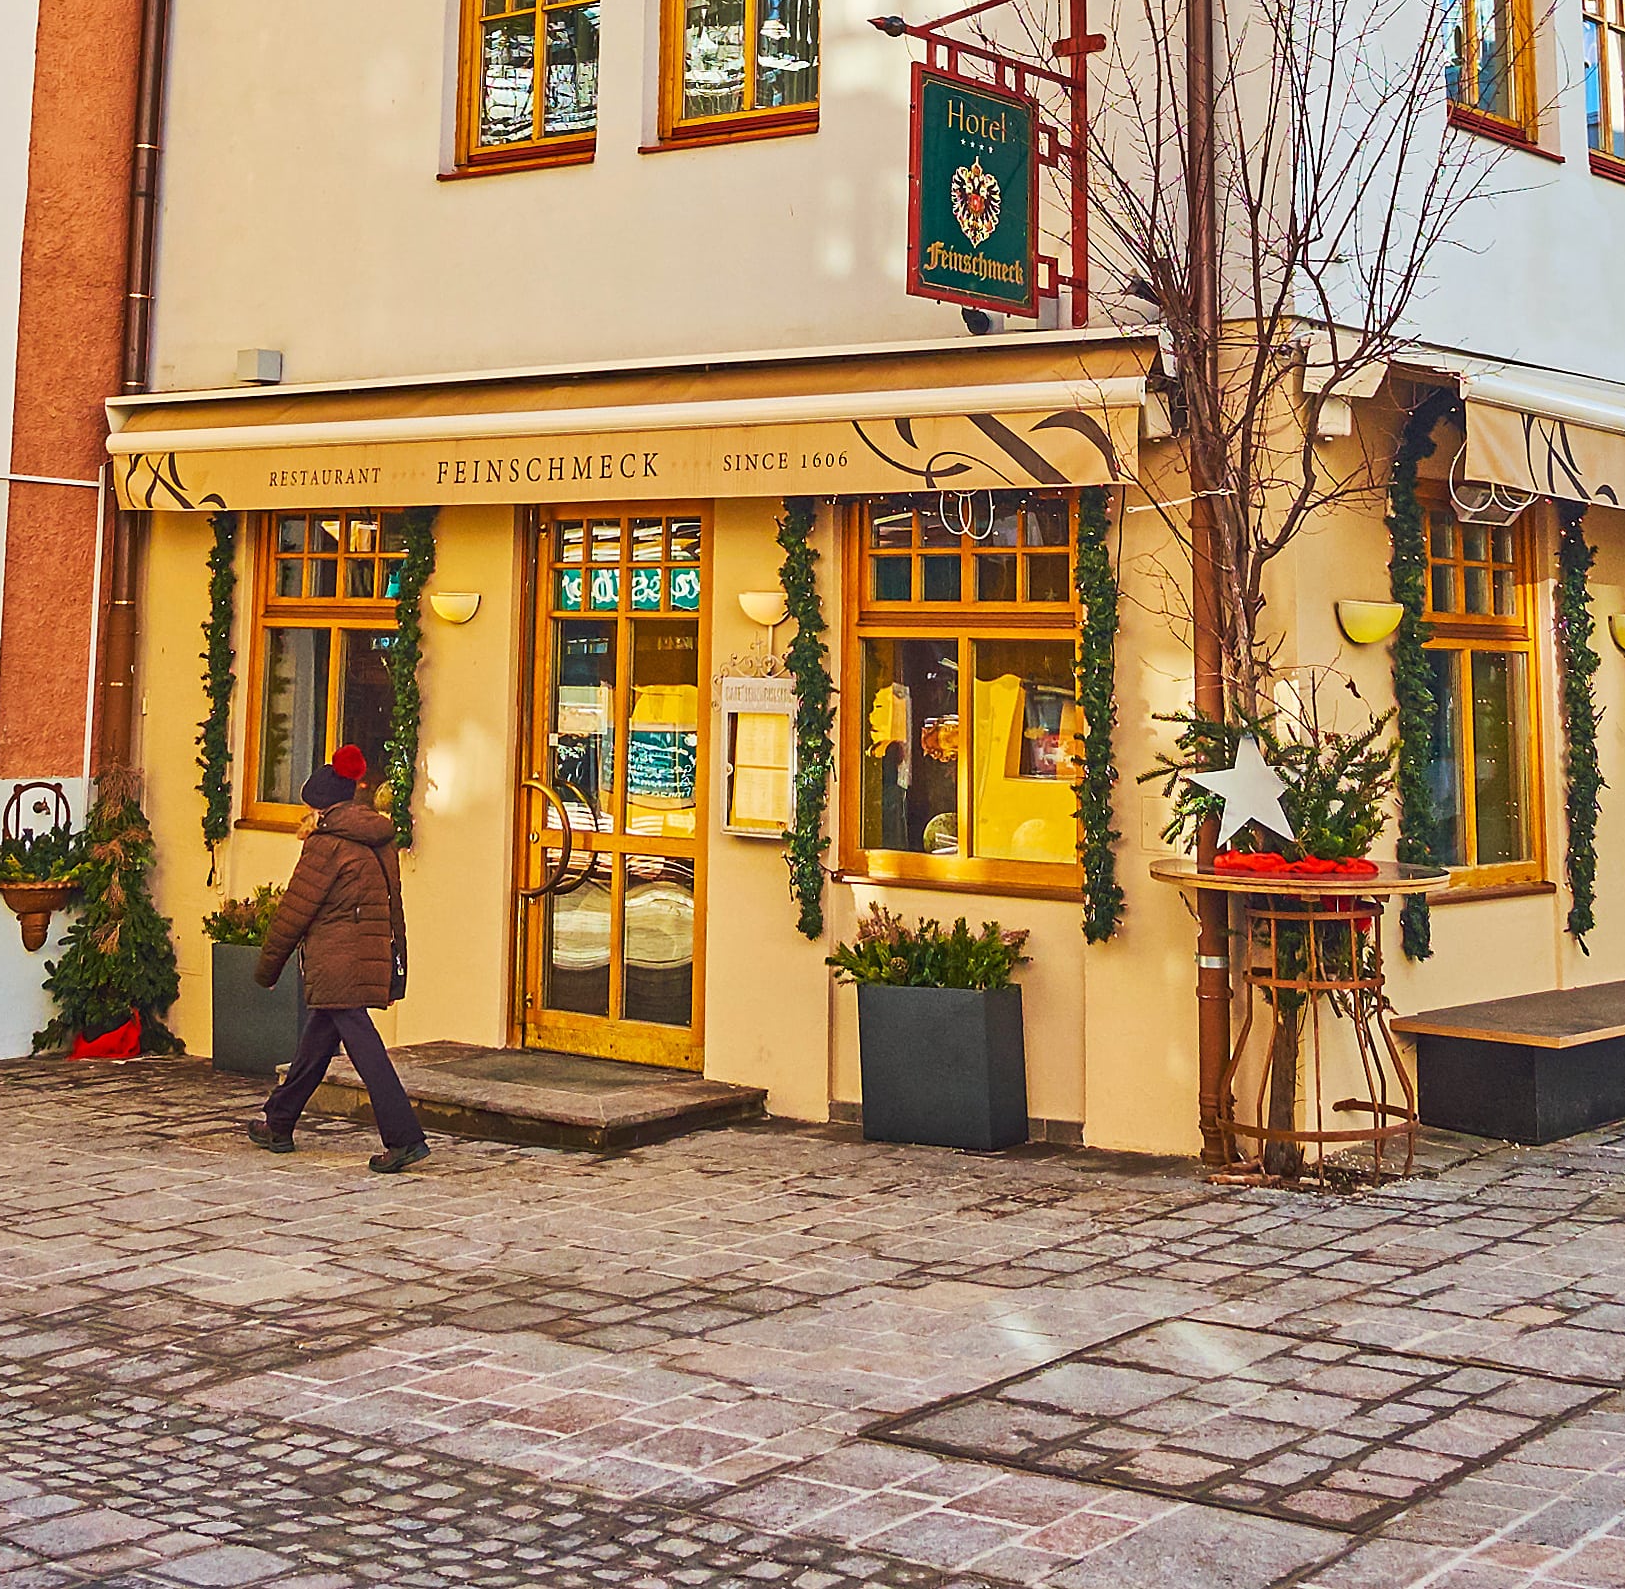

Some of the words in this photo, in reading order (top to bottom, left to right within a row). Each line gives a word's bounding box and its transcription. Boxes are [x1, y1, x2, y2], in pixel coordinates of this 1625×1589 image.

[946, 99, 1007, 144] Hotel
[922, 242, 1025, 285] Feinschmeck
[269, 467, 382, 488] RESTAURANT
[436, 452, 661, 485] FEINSCHMECK
[723, 452, 790, 472] SINCE
[800, 450, 849, 469] 1606
